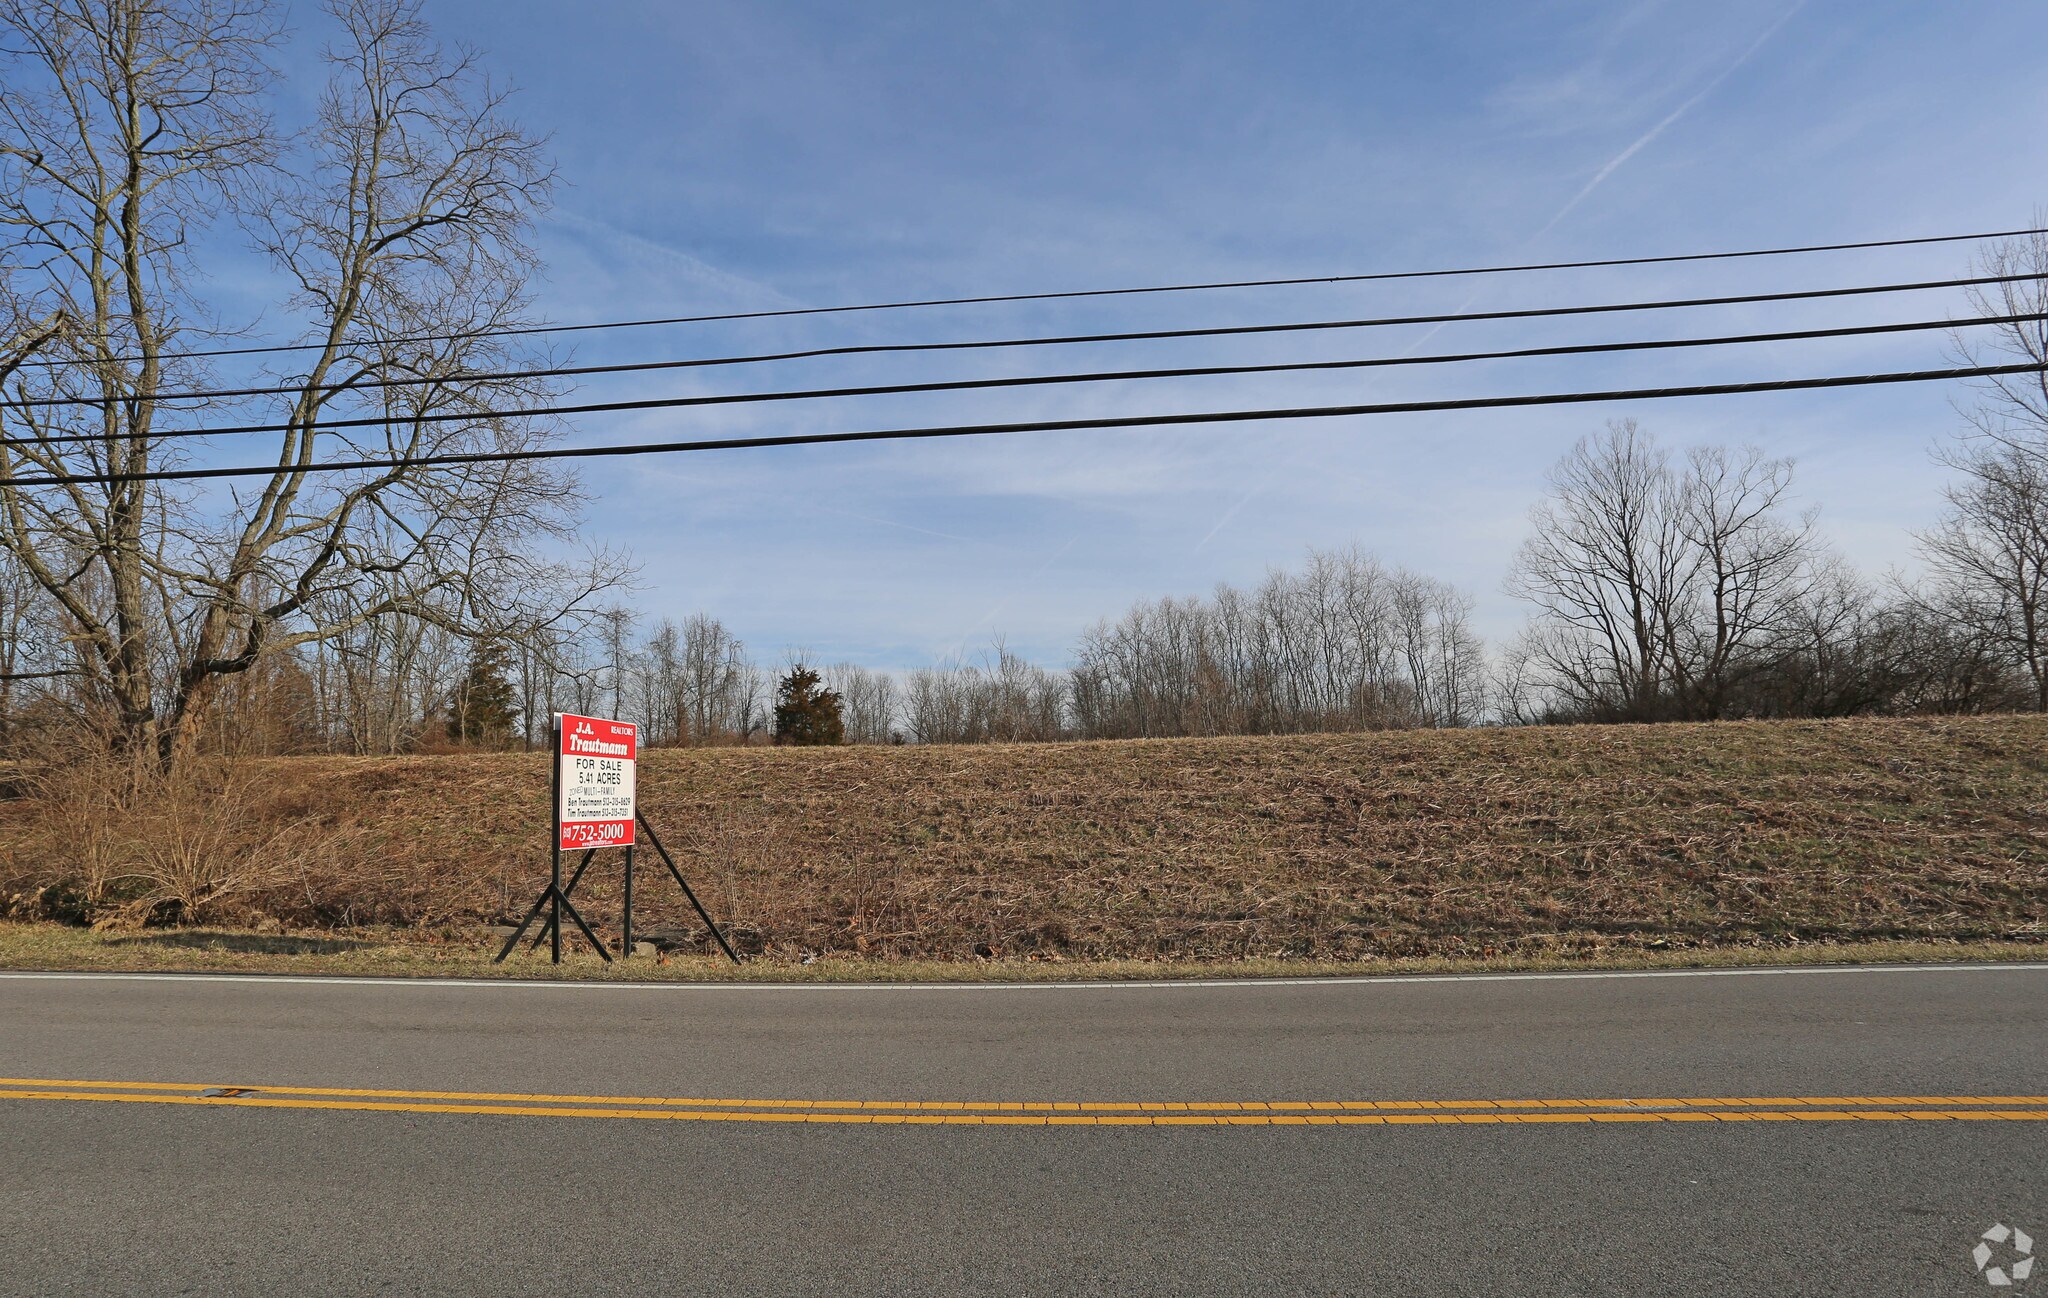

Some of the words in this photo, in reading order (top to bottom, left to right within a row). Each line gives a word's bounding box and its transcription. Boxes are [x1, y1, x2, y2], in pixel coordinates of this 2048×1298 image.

[576, 722, 594, 735] J.A.
[611, 726, 633, 737] REALTORS
[570, 733, 628, 755] Trautmann
[576, 758, 595, 769] FOR
[600, 759, 622, 771] SALE
[579, 772, 593, 784] 5.41
[597, 772, 621, 784] ACRES
[584, 786, 615, 796] MULTI-FAMILY
[578, 797, 602, 806] Trautmann
[577, 808, 601, 817] Trautmann
[572, 823, 624, 841] 752-5000
